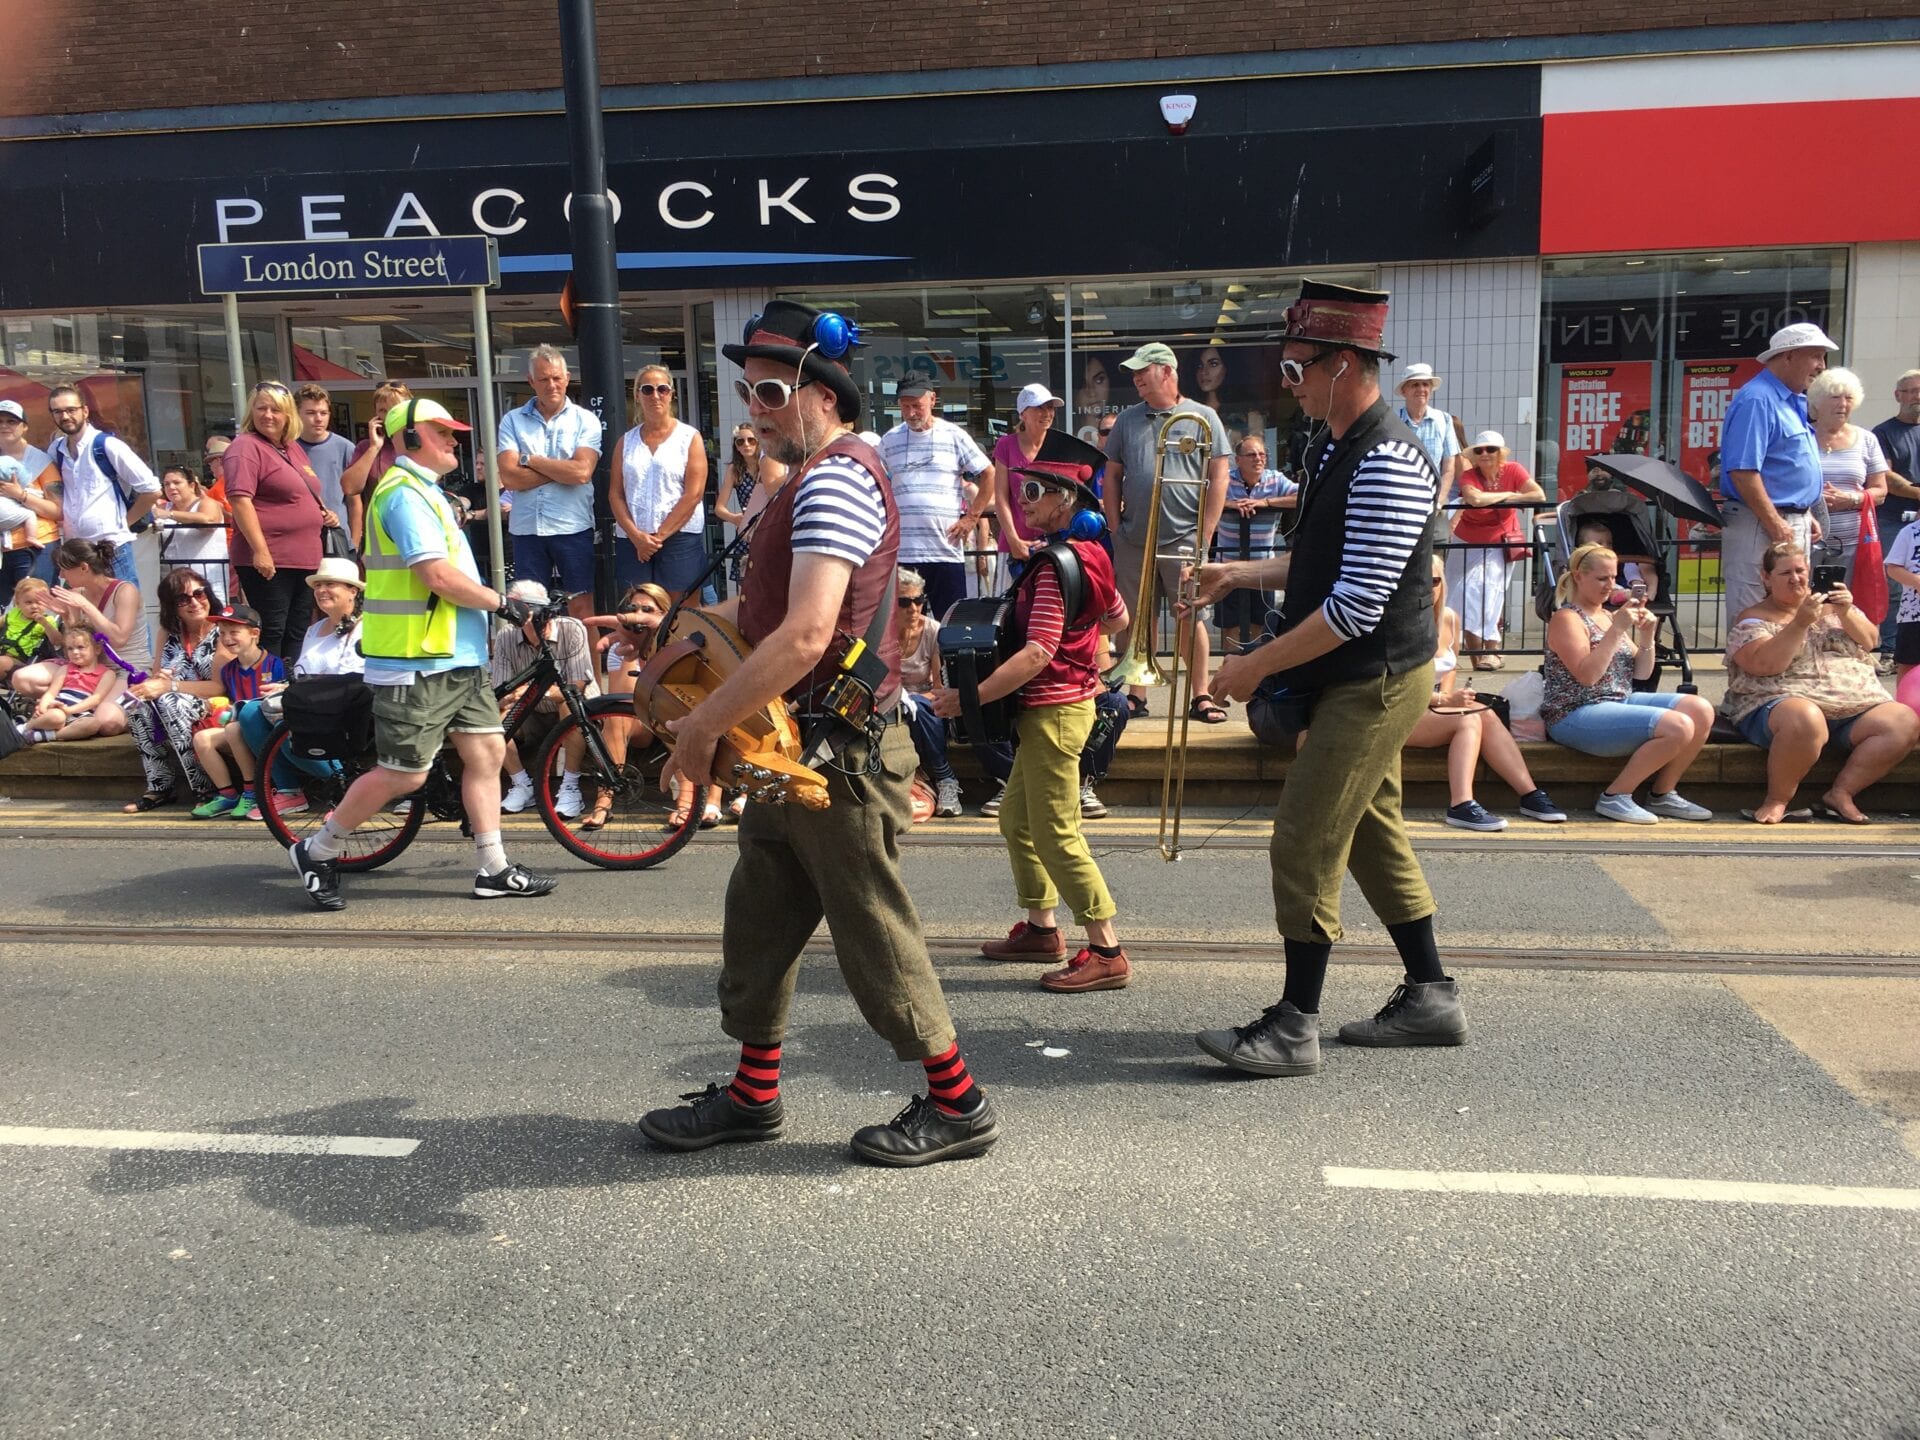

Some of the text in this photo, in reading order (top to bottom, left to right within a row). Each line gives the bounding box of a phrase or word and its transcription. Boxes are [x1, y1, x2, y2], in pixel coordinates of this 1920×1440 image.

[241, 250, 448, 282] London Street
[590, 396, 604, 406] CF
[1567, 392, 1621, 423] FREE
